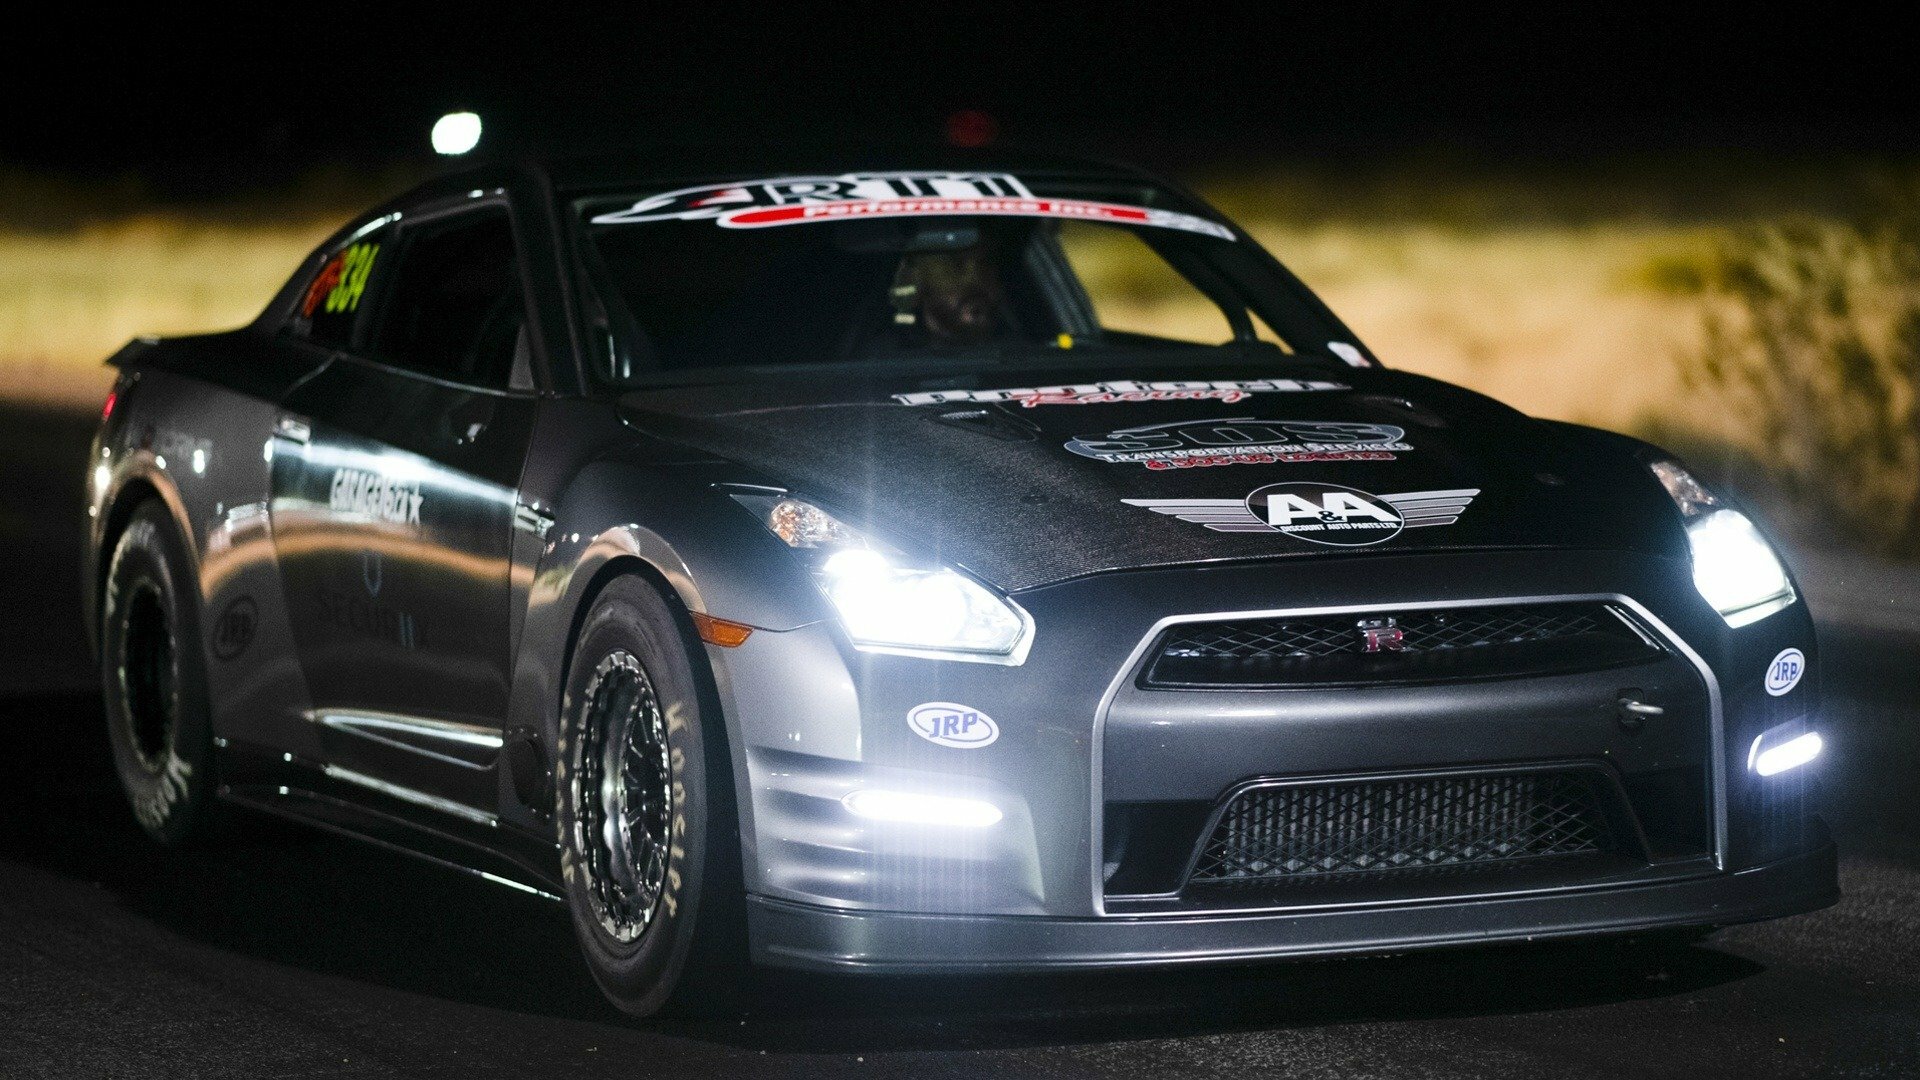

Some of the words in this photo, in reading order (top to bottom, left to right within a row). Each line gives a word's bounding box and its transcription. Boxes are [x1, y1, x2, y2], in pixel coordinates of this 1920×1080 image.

[803, 200, 1038, 217] Performance
[1267, 492, 1401, 525] A&A
[1775, 661, 1797, 681] JRP
[929, 712, 978, 738] JRP
